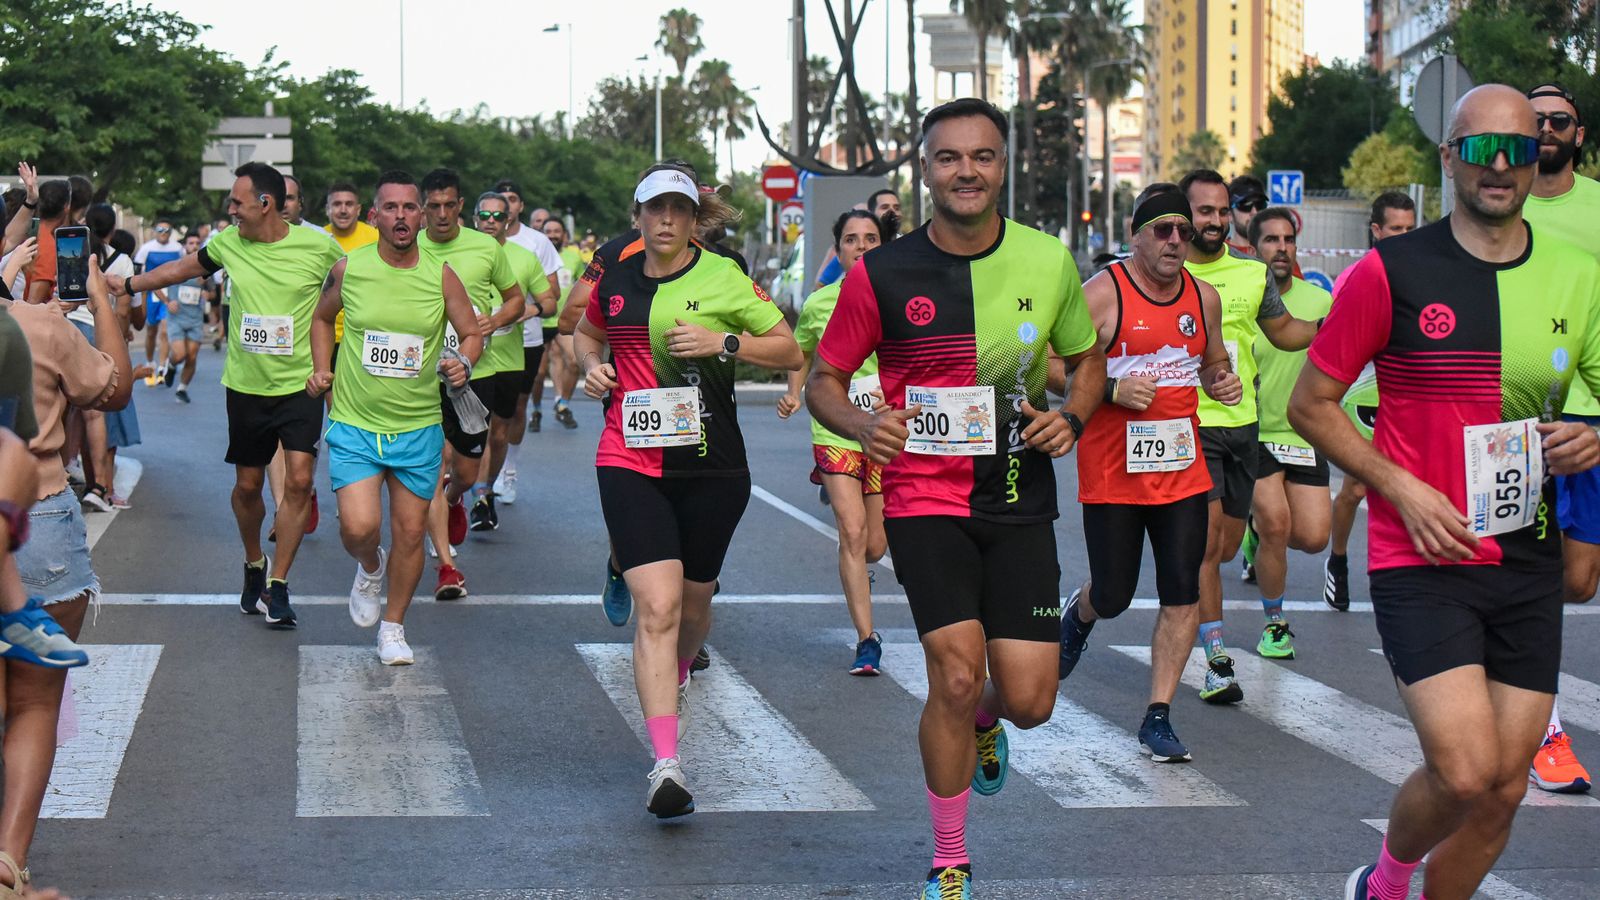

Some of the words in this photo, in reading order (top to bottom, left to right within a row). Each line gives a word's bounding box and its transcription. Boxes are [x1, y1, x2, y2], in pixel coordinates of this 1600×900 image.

[783, 213, 805, 226] 30
[244, 328, 268, 344] 599
[367, 334, 378, 342] XXI
[370, 347, 399, 365] 809
[1130, 370, 1157, 378] SAN
[1159, 370, 1193, 380] ROQUE
[625, 395, 638, 404] XXI
[853, 393, 872, 409] 40
[908, 392, 922, 403] XXI
[627, 410, 662, 432] 499
[913, 411, 950, 437] 500
[1130, 425, 1143, 434] XXI
[1132, 439, 1166, 458] 479
[1470, 439, 1478, 467] MANUEL
[1494, 468, 1522, 519] 955
[1474, 513, 1486, 532] XXI
